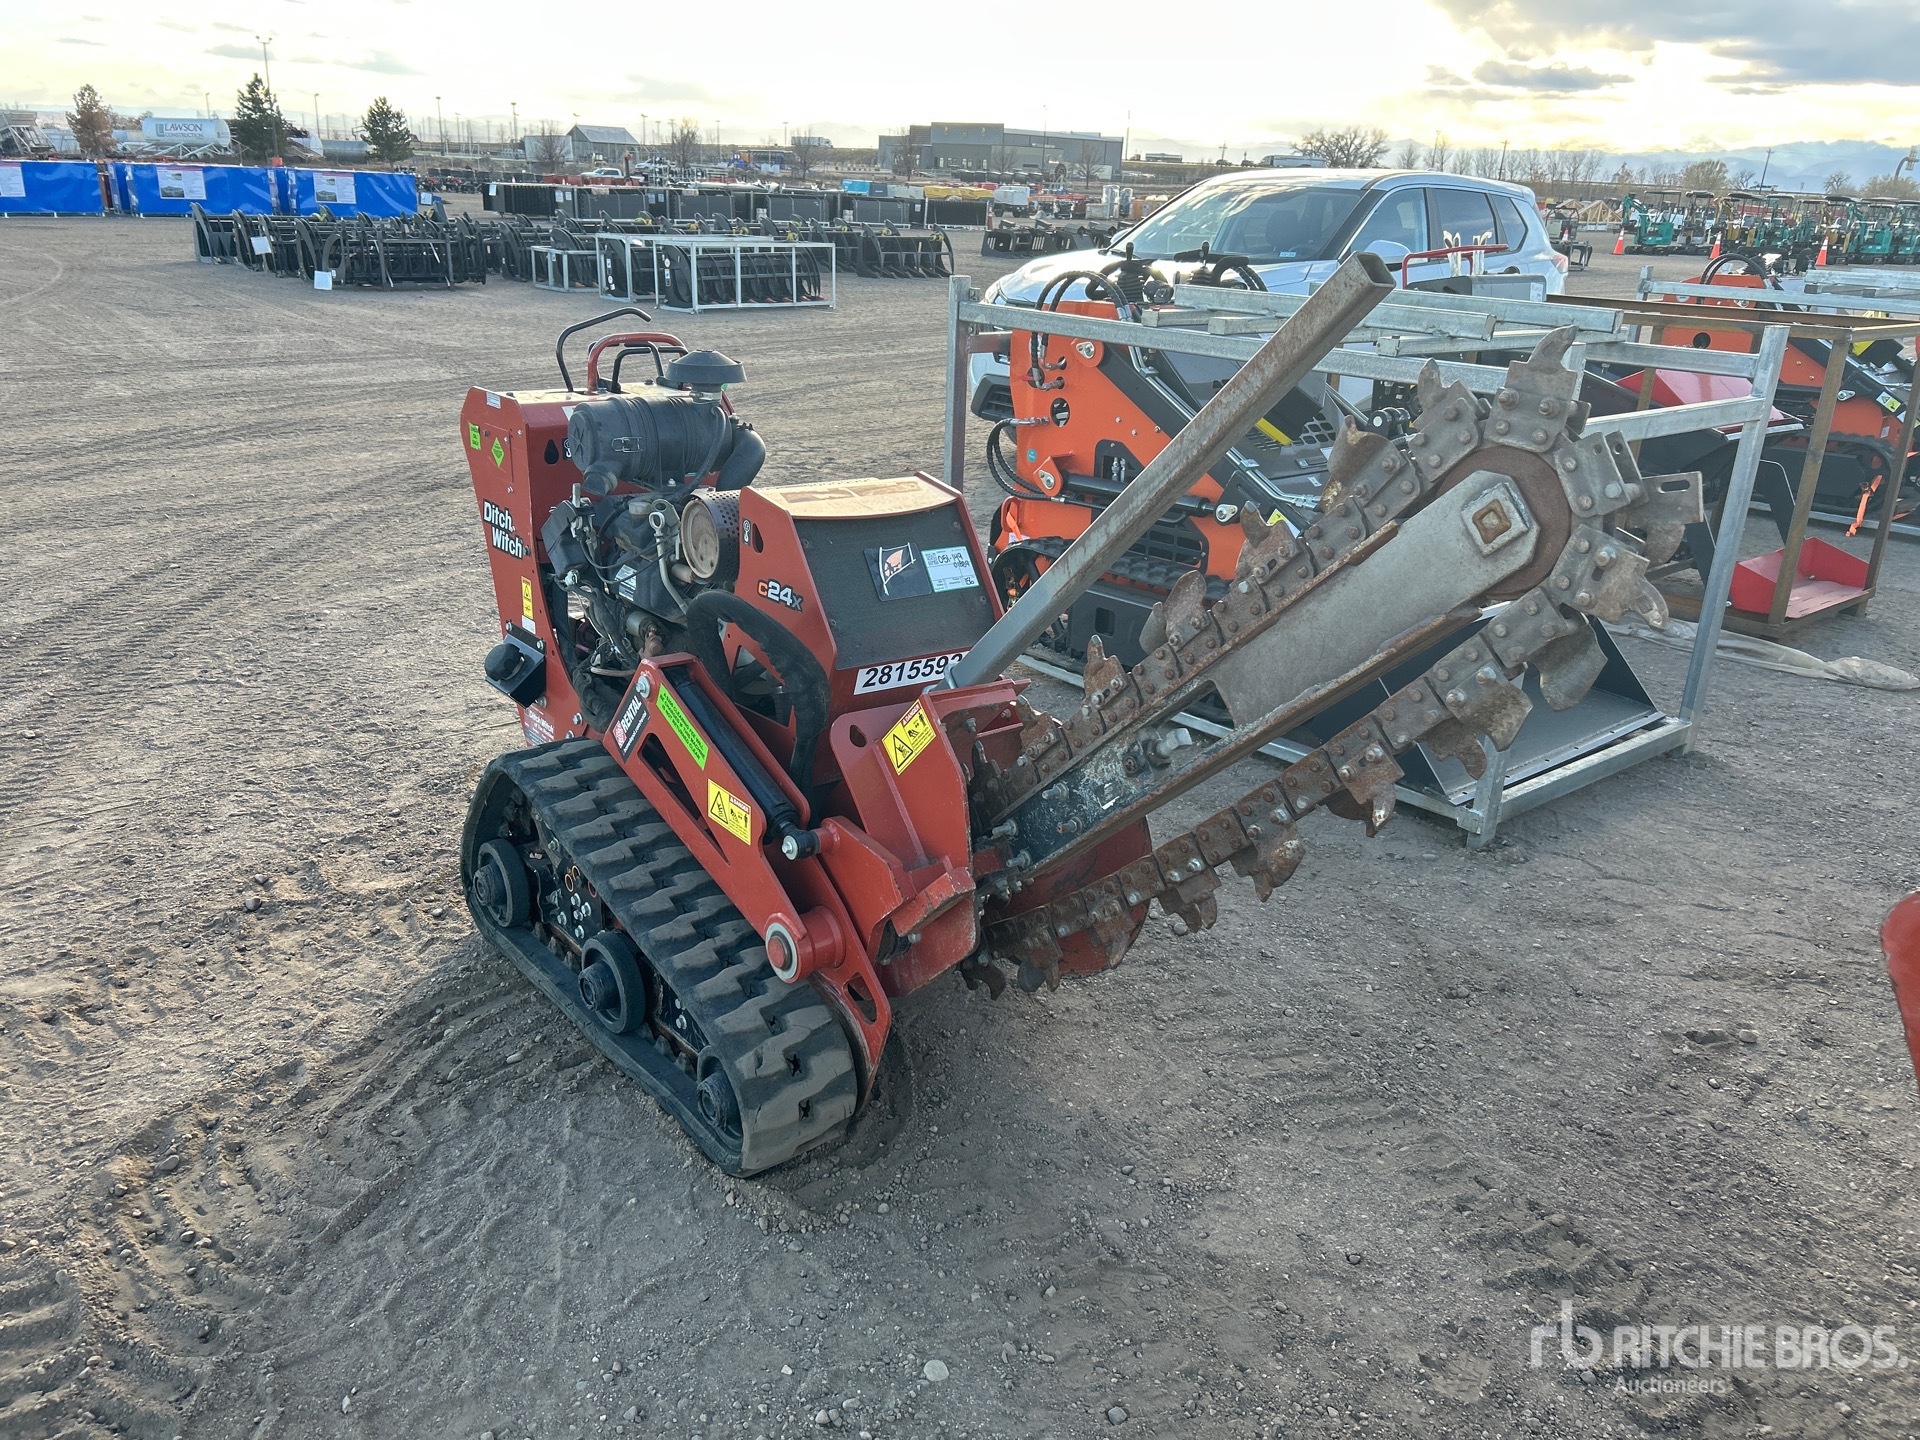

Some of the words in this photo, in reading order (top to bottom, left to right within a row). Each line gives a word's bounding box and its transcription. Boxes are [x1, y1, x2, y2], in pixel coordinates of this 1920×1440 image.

[164, 123, 203, 132] LAWSON
[483, 500, 514, 531] Ditch
[491, 526, 523, 559] Witch
[619, 695, 642, 733] RENTAL
[673, 704, 689, 730] CLEANING
[905, 703, 921, 723] DANGER
[672, 717, 688, 744] RETURNED
[688, 741, 700, 761] CLEAN
[690, 735, 705, 760] MACHINE
[732, 797, 750, 815] DANGER
